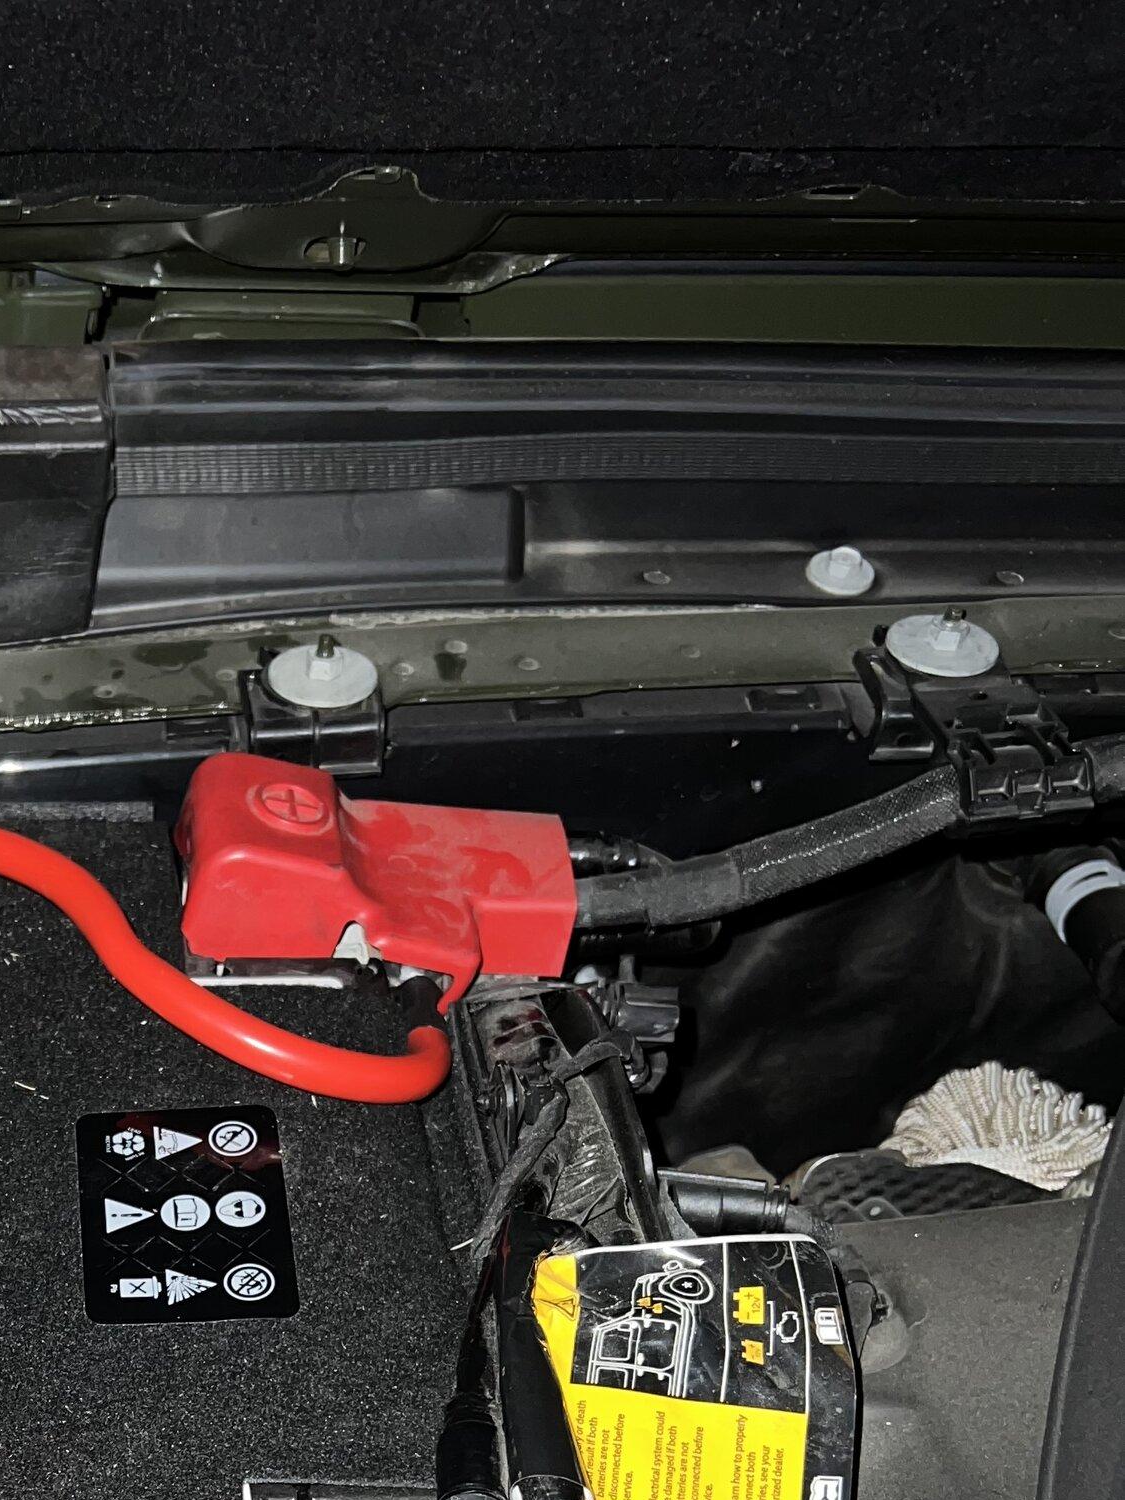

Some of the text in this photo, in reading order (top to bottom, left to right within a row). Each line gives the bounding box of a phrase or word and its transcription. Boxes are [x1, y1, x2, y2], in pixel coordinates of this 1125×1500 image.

[576, 1400, 586, 1424] death
[576, 1426, 583, 1436] or
[589, 1417, 598, 1438] both
[656, 1411, 666, 1435] could
[736, 1414, 748, 1452] properly
[586, 1437, 595, 1446] if
[668, 1425, 677, 1443] both
[693, 1426, 704, 1454] before
[586, 1447, 595, 1471] result
[609, 1413, 625, 1500] disconnected before
[654, 1437, 663, 1467] system
[666, 1444, 675, 1454] if
[681, 1442, 689, 1457] not
[734, 1453, 743, 1463] to
[762, 1445, 771, 1466] your
[597, 1429, 610, 1498] batteries are not
[680, 1458, 688, 1472] are
[747, 1451, 756, 1470] both
[774, 1448, 784, 1476] dealer.
[663, 1455, 675, 1496] damaged
[731, 1465, 742, 1484] how
[761, 1467, 769, 1482] see
